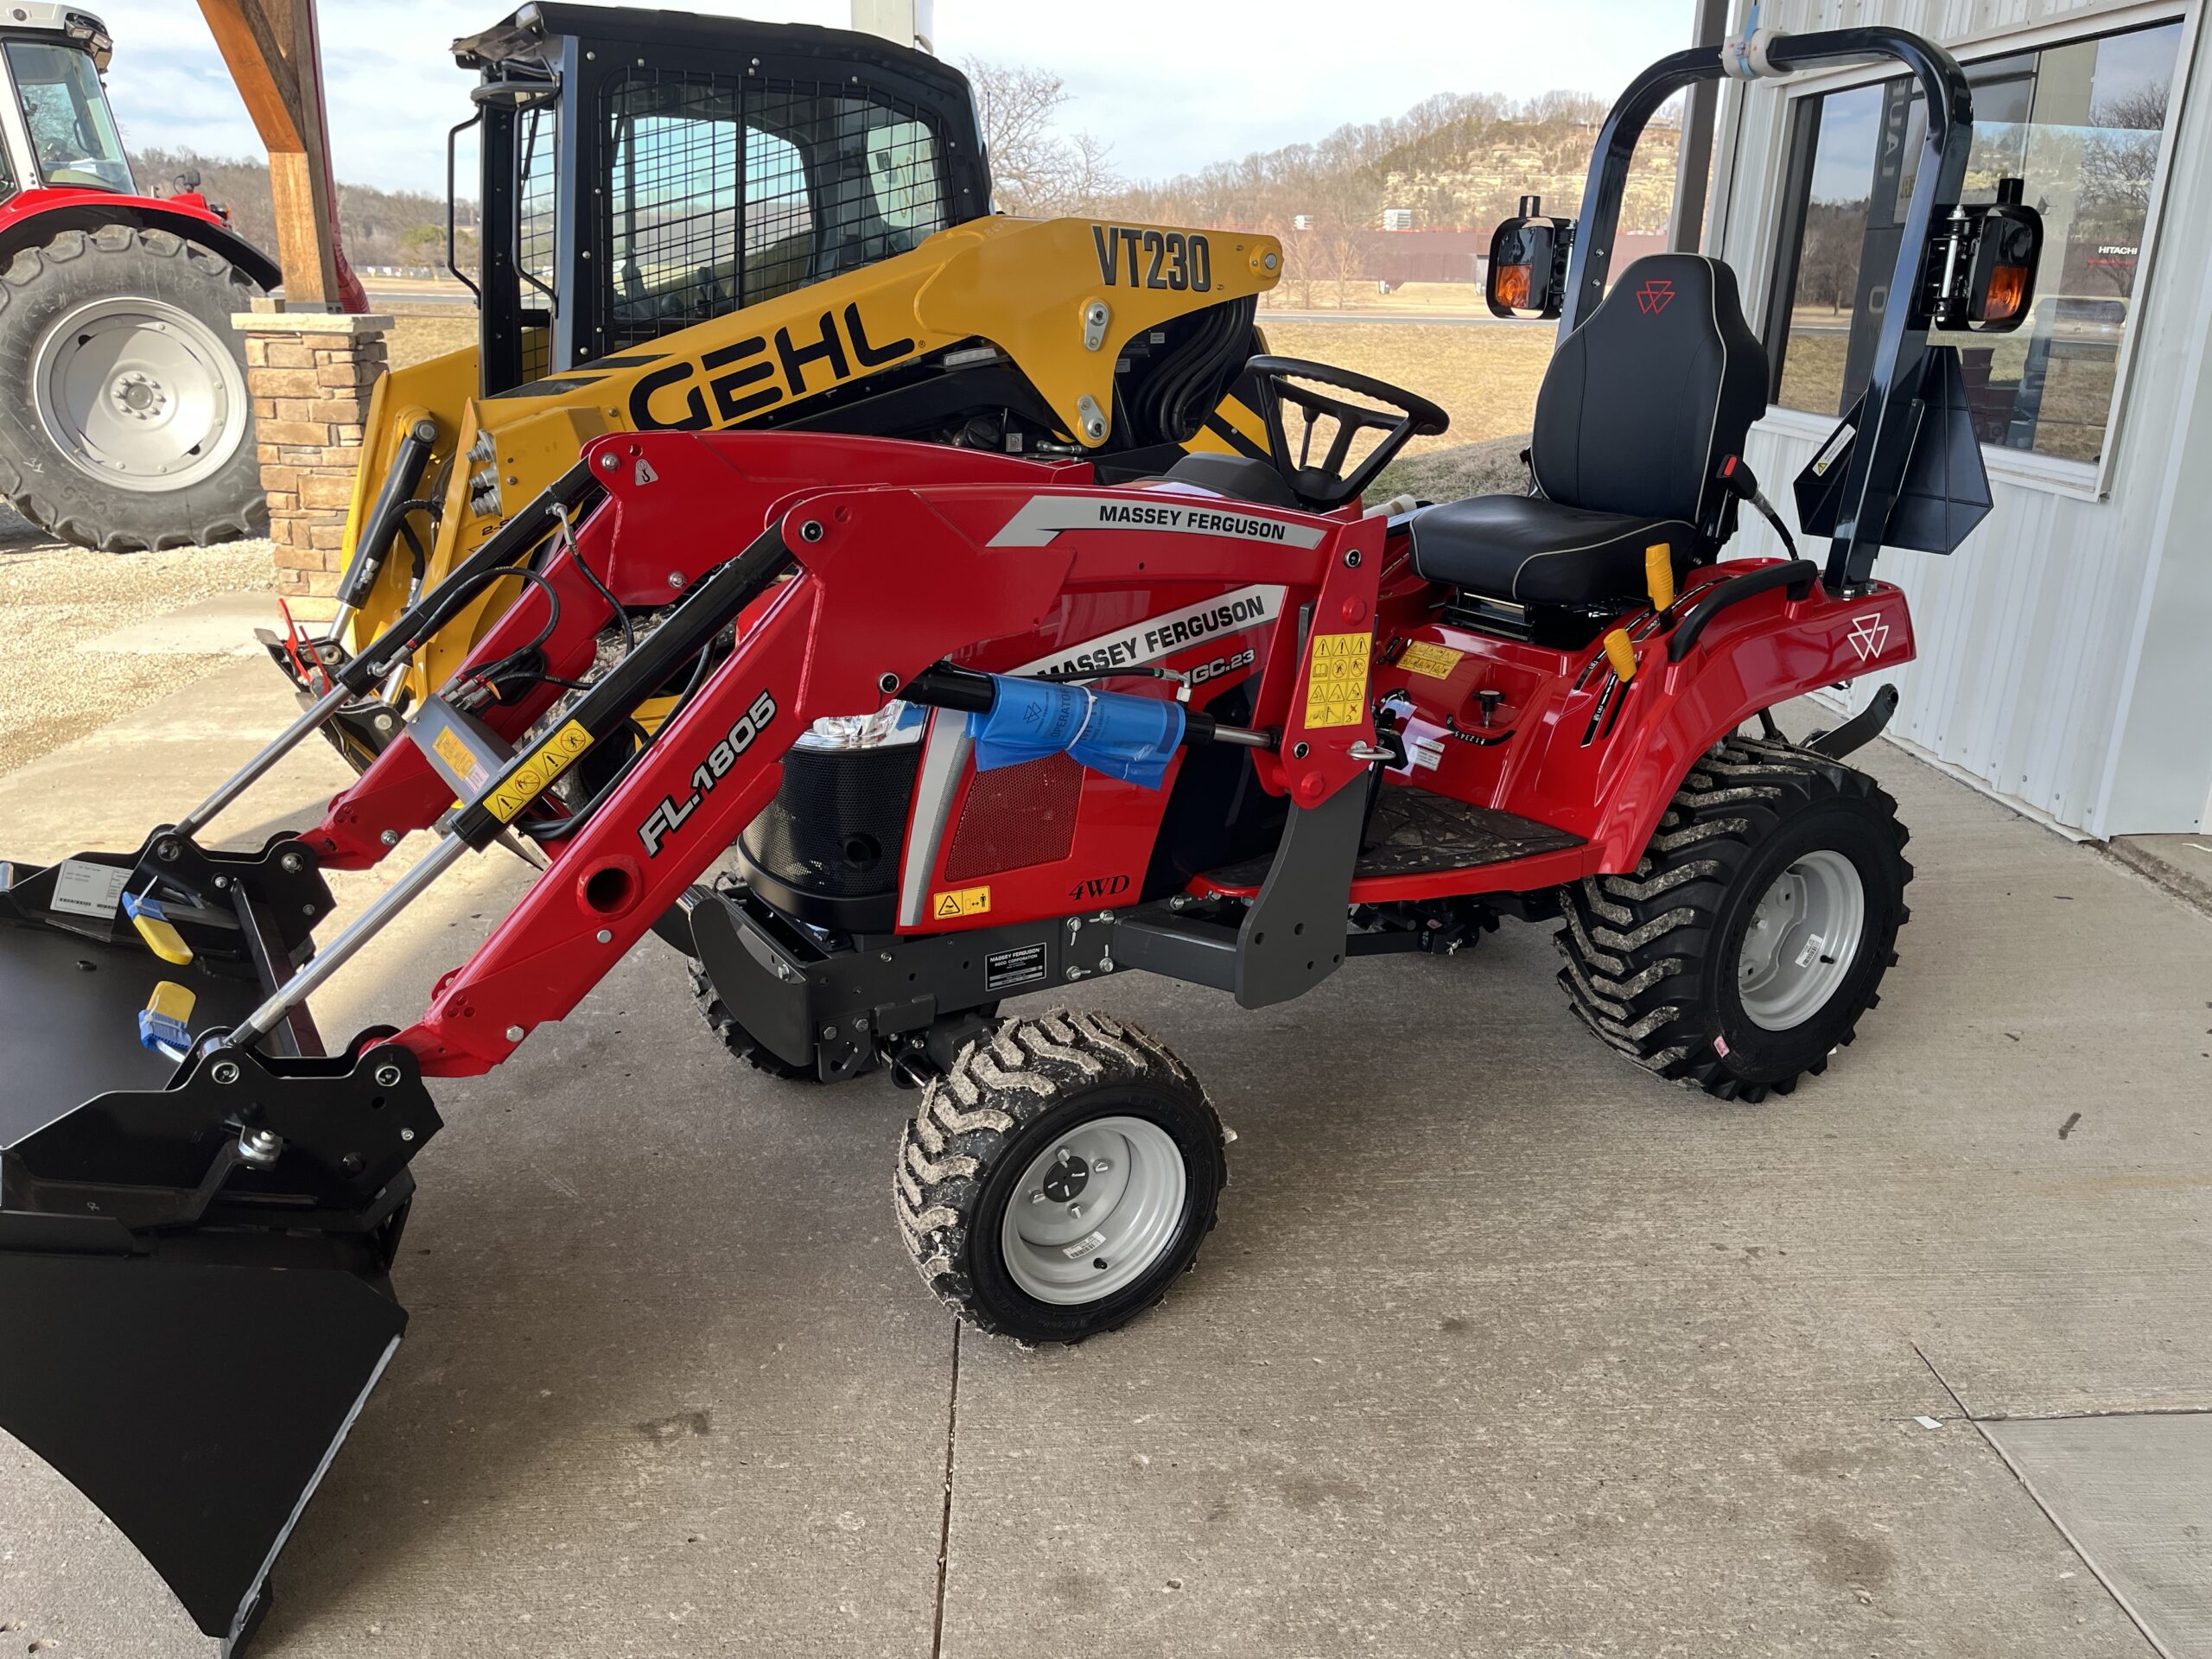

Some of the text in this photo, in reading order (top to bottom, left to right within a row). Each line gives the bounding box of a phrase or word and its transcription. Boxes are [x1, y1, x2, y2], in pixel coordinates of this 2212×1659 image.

[1091, 225, 1211, 293] VT230
[2098, 245, 2139, 255] HITACHI
[629, 302, 916, 432] GEHL
[1099, 505, 1286, 541] MASSEY FERGUSON
[1144, 595, 1265, 653] FERGUSON
[637, 689, 777, 859] FL.1805
[1068, 874, 1130, 902] 4WD
